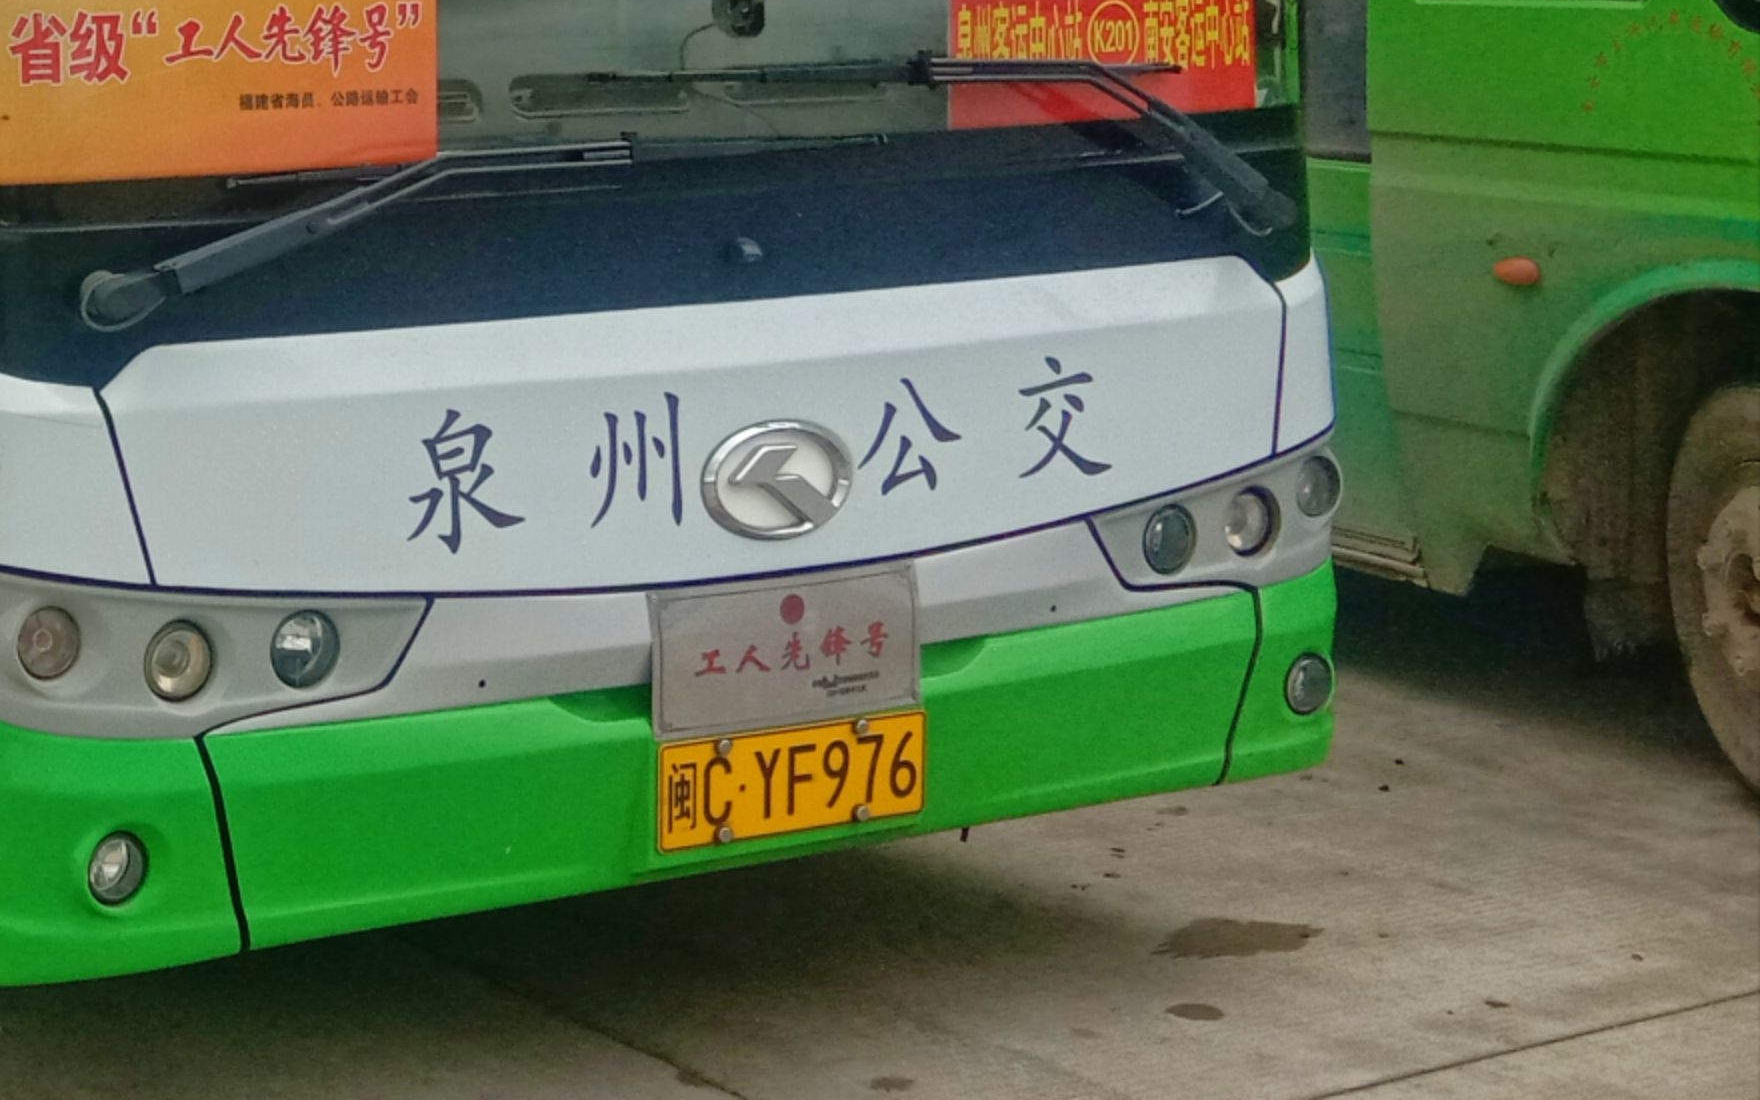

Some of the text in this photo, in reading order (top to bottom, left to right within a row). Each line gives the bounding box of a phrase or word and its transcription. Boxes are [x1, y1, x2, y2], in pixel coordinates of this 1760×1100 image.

[1093, 19, 1135, 54] K201
[694, 621, 888, 677] 工人先锋号
